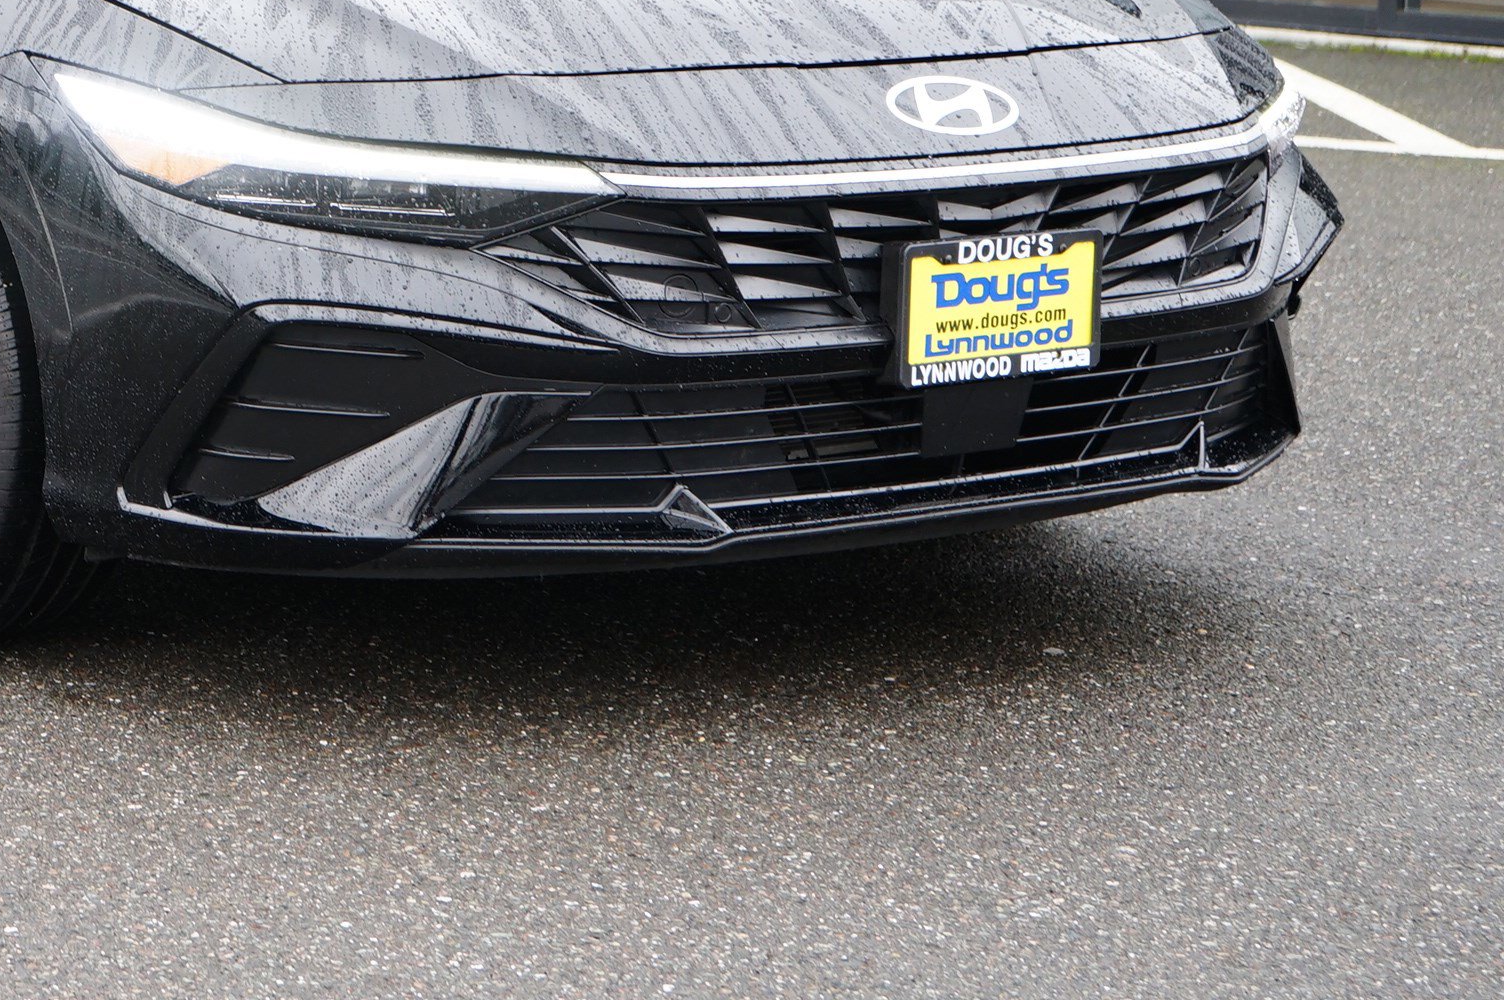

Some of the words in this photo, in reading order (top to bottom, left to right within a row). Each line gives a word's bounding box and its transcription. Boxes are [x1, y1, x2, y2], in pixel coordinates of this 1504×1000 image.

[957, 232, 1054, 264] DOUG'S
[931, 263, 1069, 311] Doug's
[935, 308, 1066, 334] www.dougs.com
[924, 318, 1073, 358] Lynnwood
[911, 355, 1012, 387] LYNNWOOD
